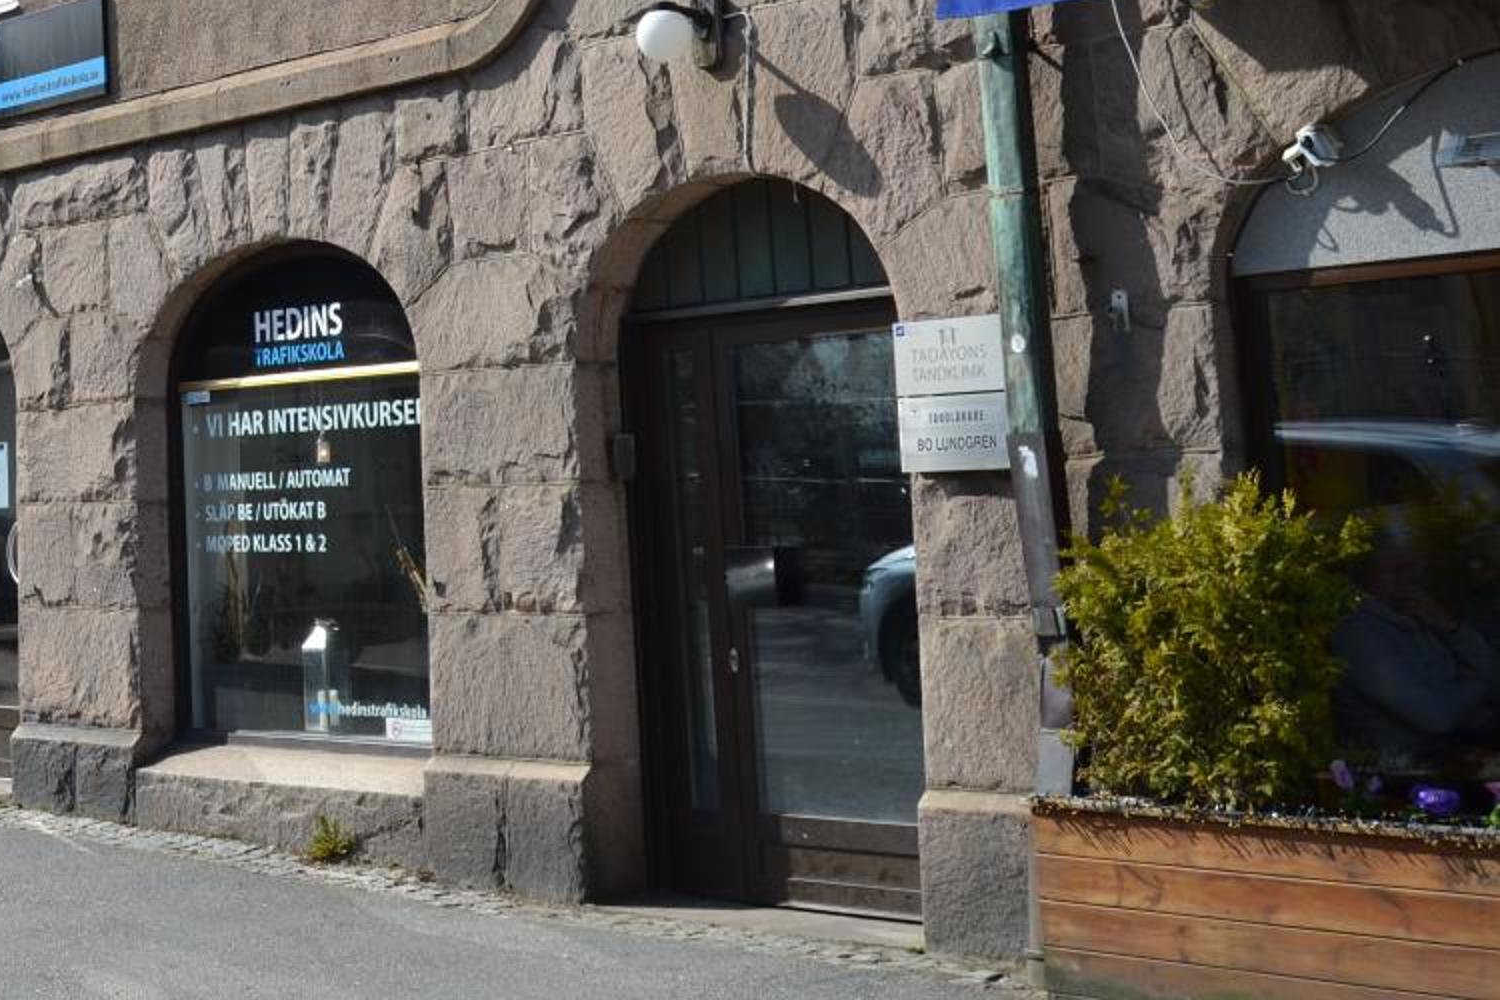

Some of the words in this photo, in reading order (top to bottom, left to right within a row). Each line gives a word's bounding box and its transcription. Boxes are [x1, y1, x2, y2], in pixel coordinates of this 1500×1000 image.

[254, 302, 343, 344] HEDINS
[255, 341, 345, 367] TRAFIKSKOLA
[206, 414, 223, 438] VI
[228, 410, 264, 436] HAR
[935, 435, 997, 451] LUNDGREN
[217, 471, 276, 490] MANUELL
[287, 467, 352, 489] AUTOMAT
[237, 503, 253, 521] BE
[263, 498, 314, 521] UTÖKAT
[317, 501, 327, 519] B
[206, 534, 250, 553] MOPED
[252, 533, 293, 552] KLASS
[304, 533, 317, 552] &
[318, 533, 327, 552] 2
